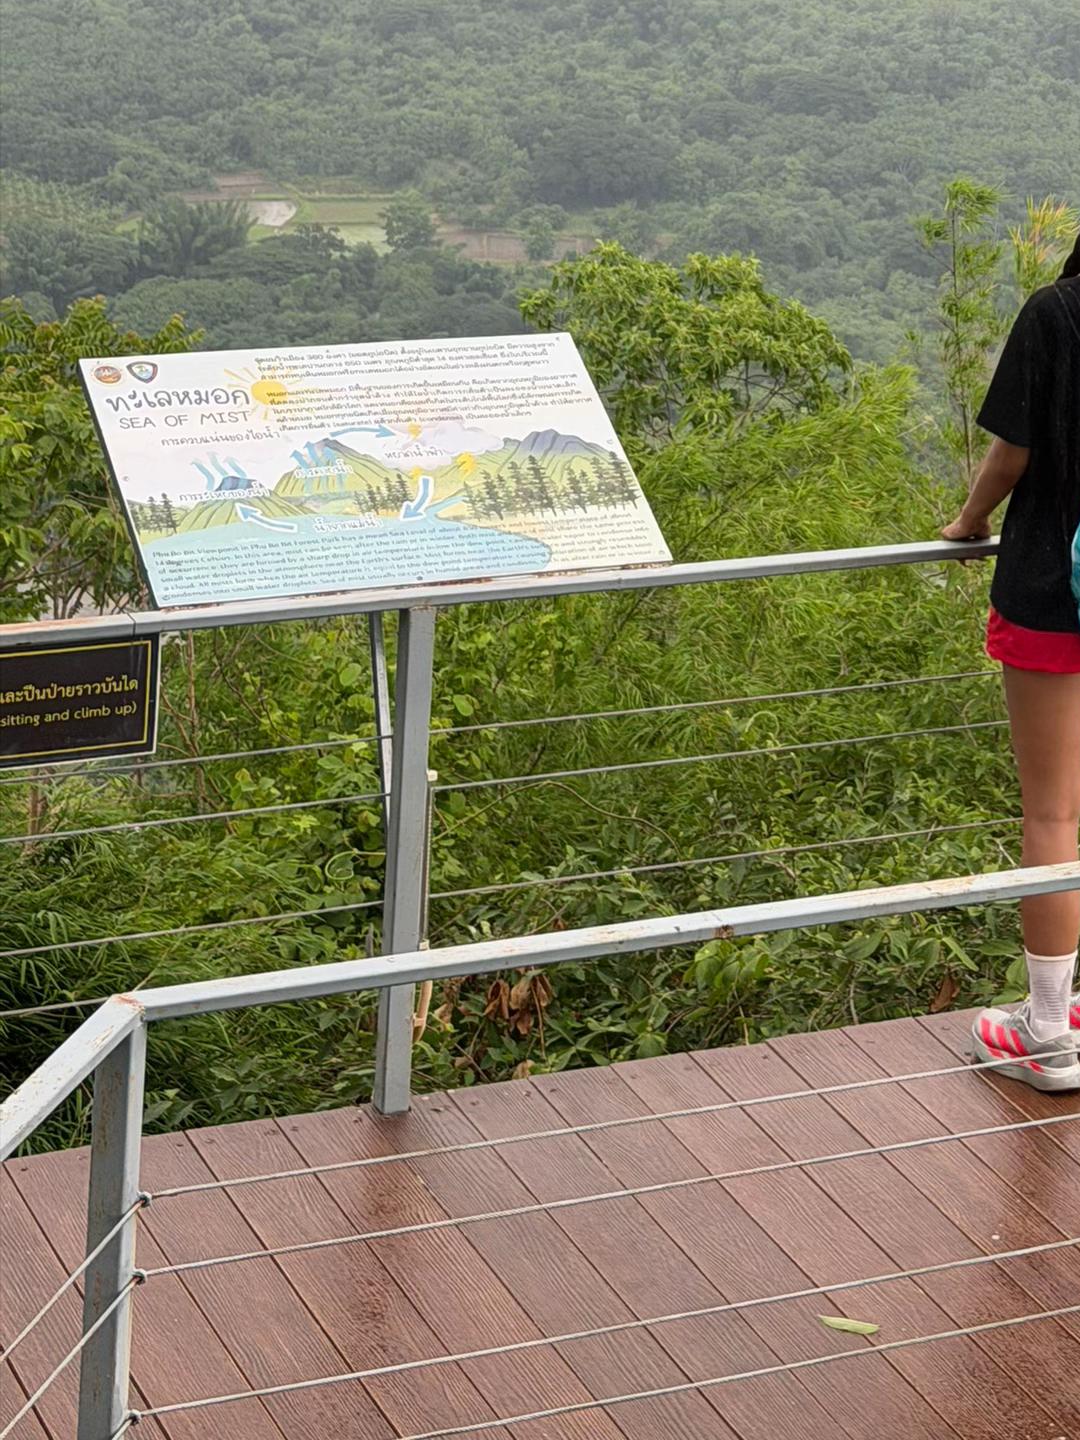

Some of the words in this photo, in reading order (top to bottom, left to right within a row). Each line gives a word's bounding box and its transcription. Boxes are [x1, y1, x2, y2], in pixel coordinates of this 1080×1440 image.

[105, 386, 250, 413] ทะเลหมอก
[118, 416, 156, 430] SEA
[164, 414, 190, 427] OF
[199, 411, 252, 425] MIST
[0, 714, 40, 727] sitting
[44, 709, 70, 722] and
[74, 705, 111, 719] climb
[115, 701, 137, 716] up)
